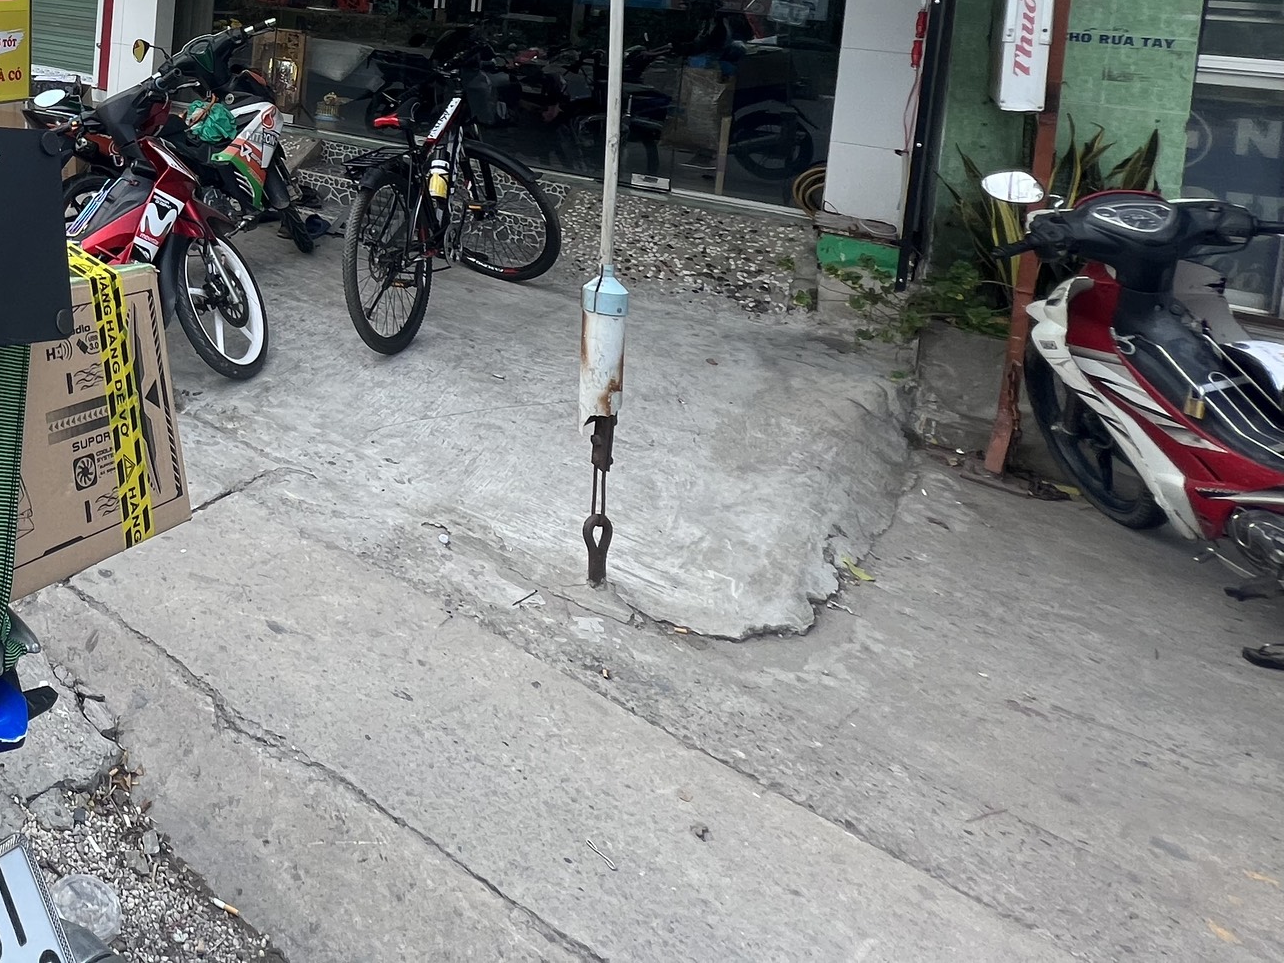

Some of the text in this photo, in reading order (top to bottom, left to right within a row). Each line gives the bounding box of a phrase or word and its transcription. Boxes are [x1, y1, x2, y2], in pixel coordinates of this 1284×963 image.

[2, 35, 18, 48] TỐT
[1141, 37, 1176, 49] TAY
[8, 67, 23, 82] CÓ
